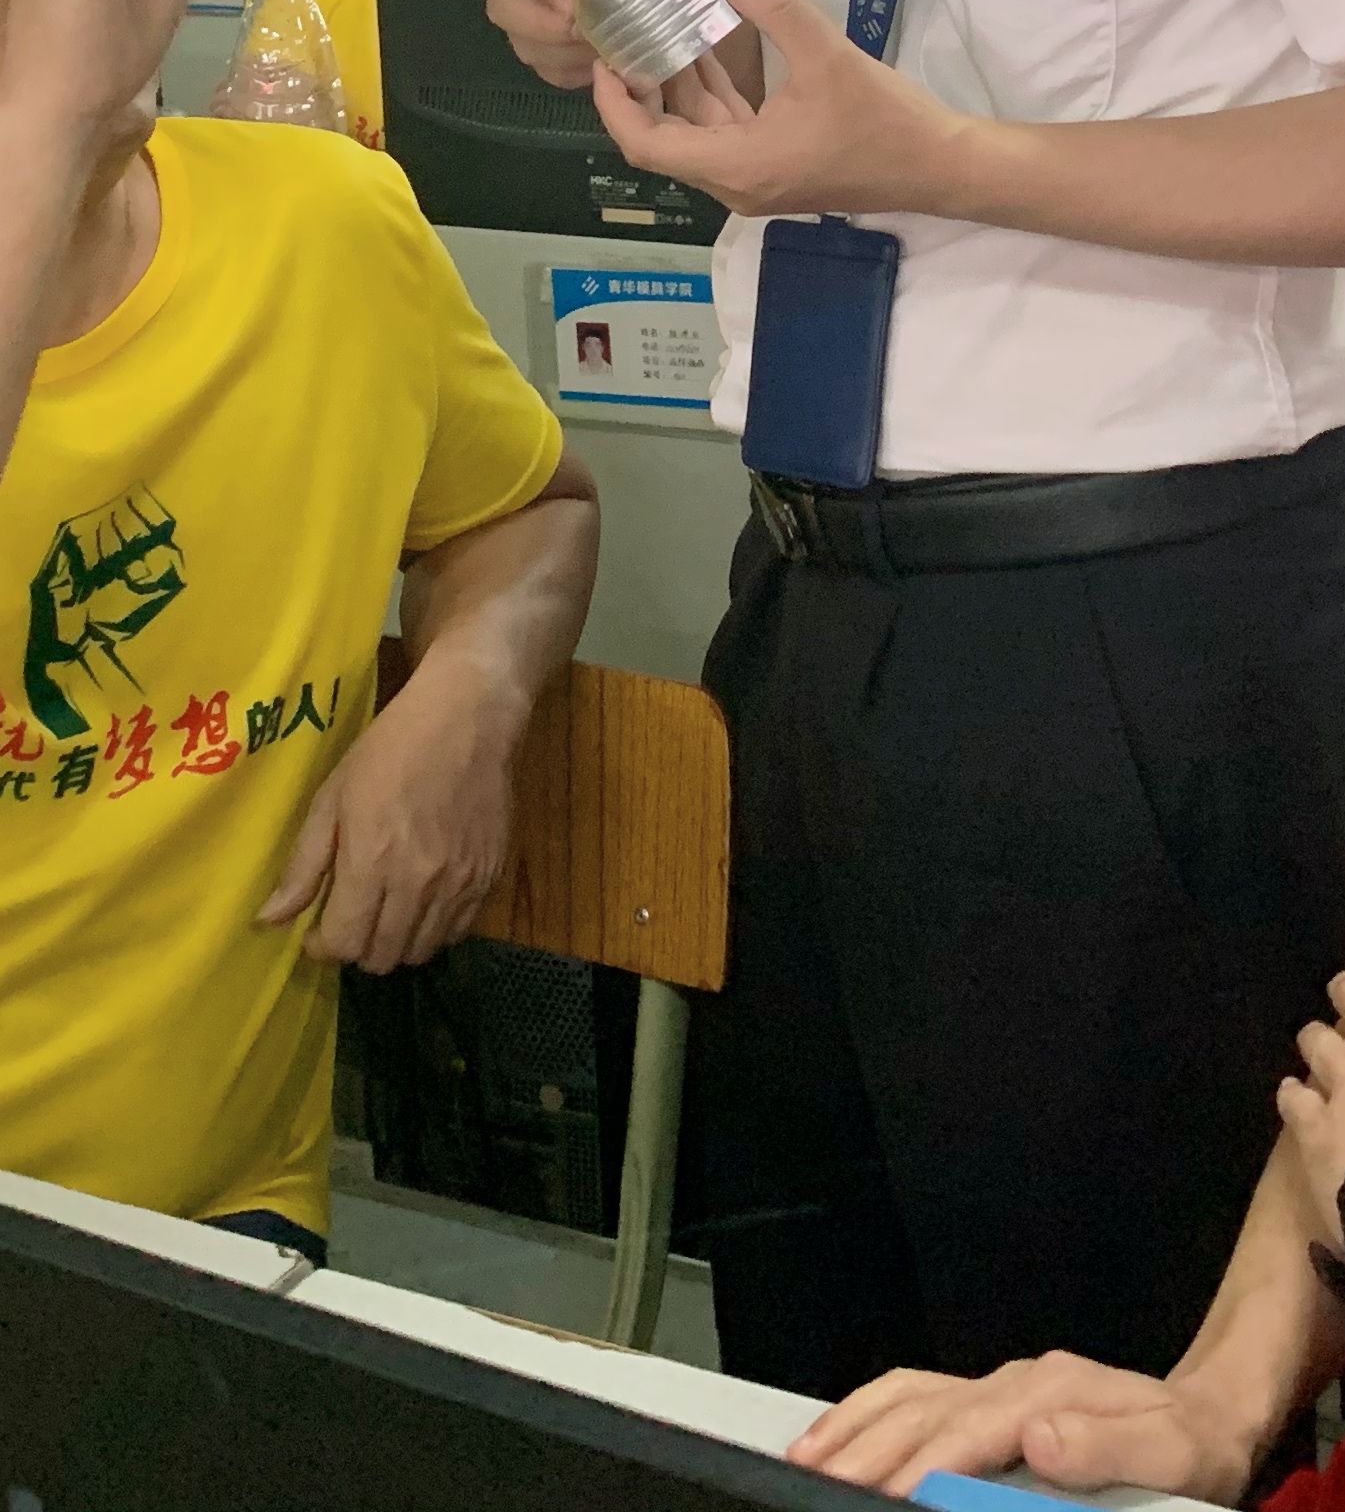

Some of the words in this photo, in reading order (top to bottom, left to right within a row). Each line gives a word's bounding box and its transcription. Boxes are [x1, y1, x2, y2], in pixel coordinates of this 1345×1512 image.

[608, 279, 693, 297] 青华模具学院
